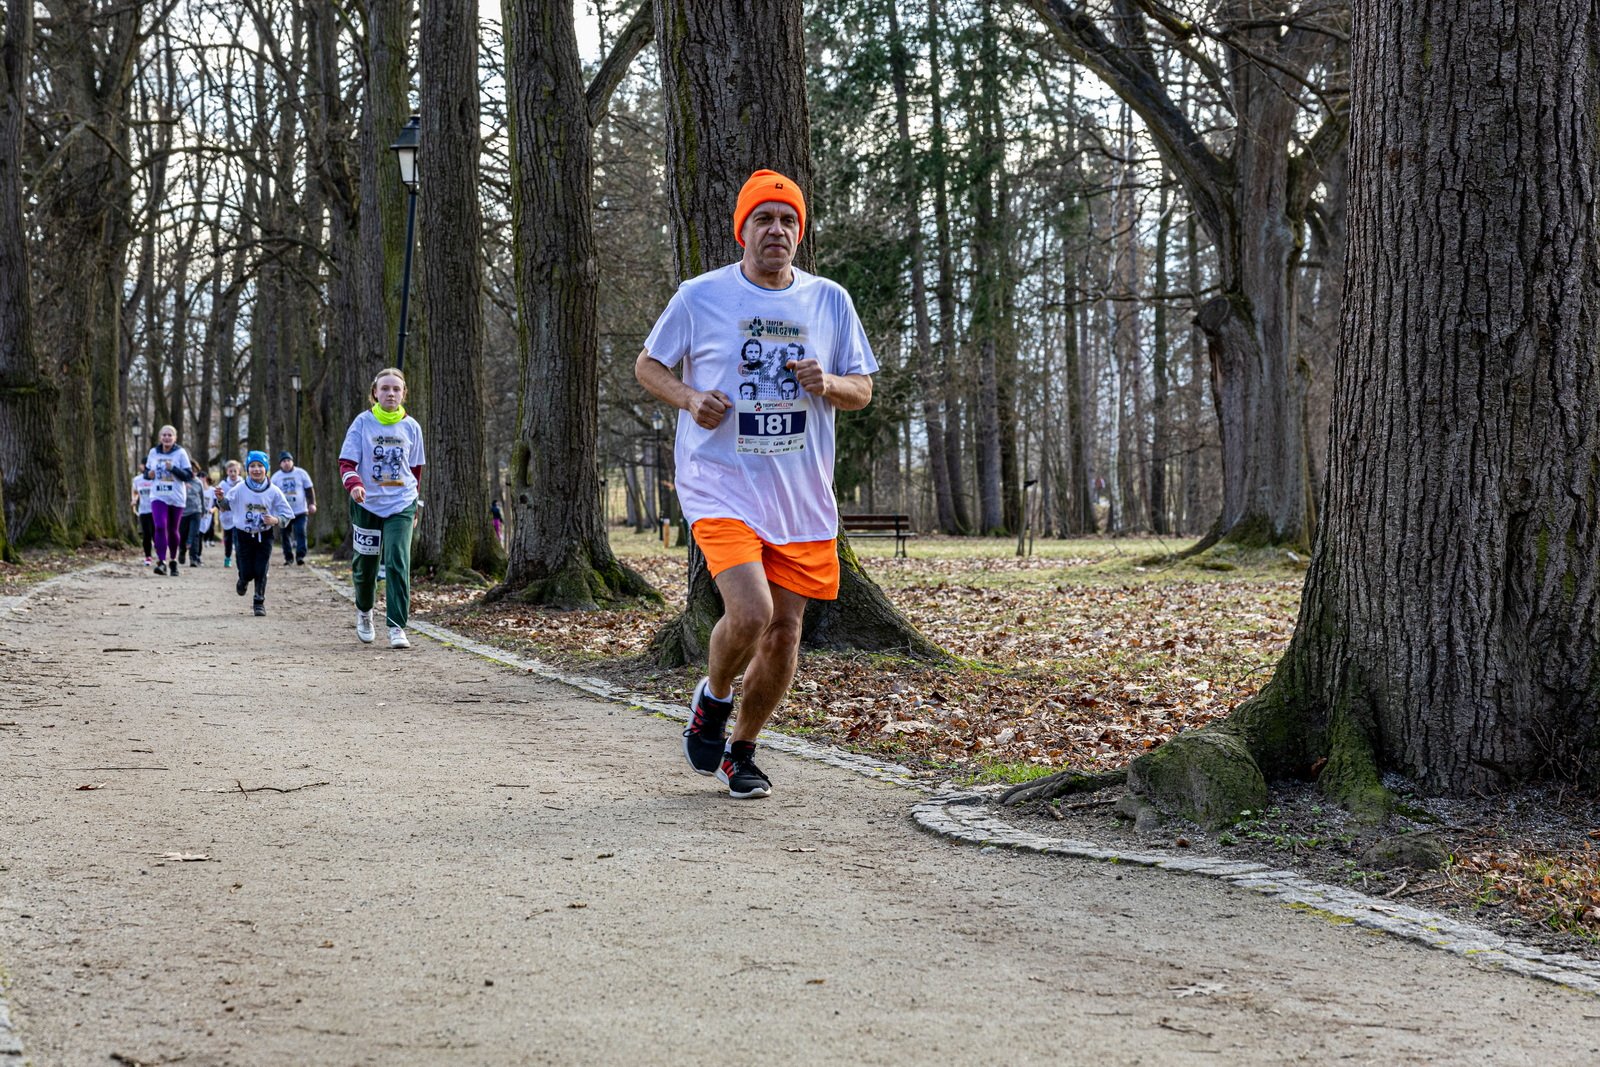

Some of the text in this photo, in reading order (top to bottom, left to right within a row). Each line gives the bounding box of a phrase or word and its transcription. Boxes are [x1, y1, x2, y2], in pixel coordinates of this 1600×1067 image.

[766, 326, 799, 336] WILCZYM
[755, 413, 792, 435] 181
[355, 532, 374, 546] 146
